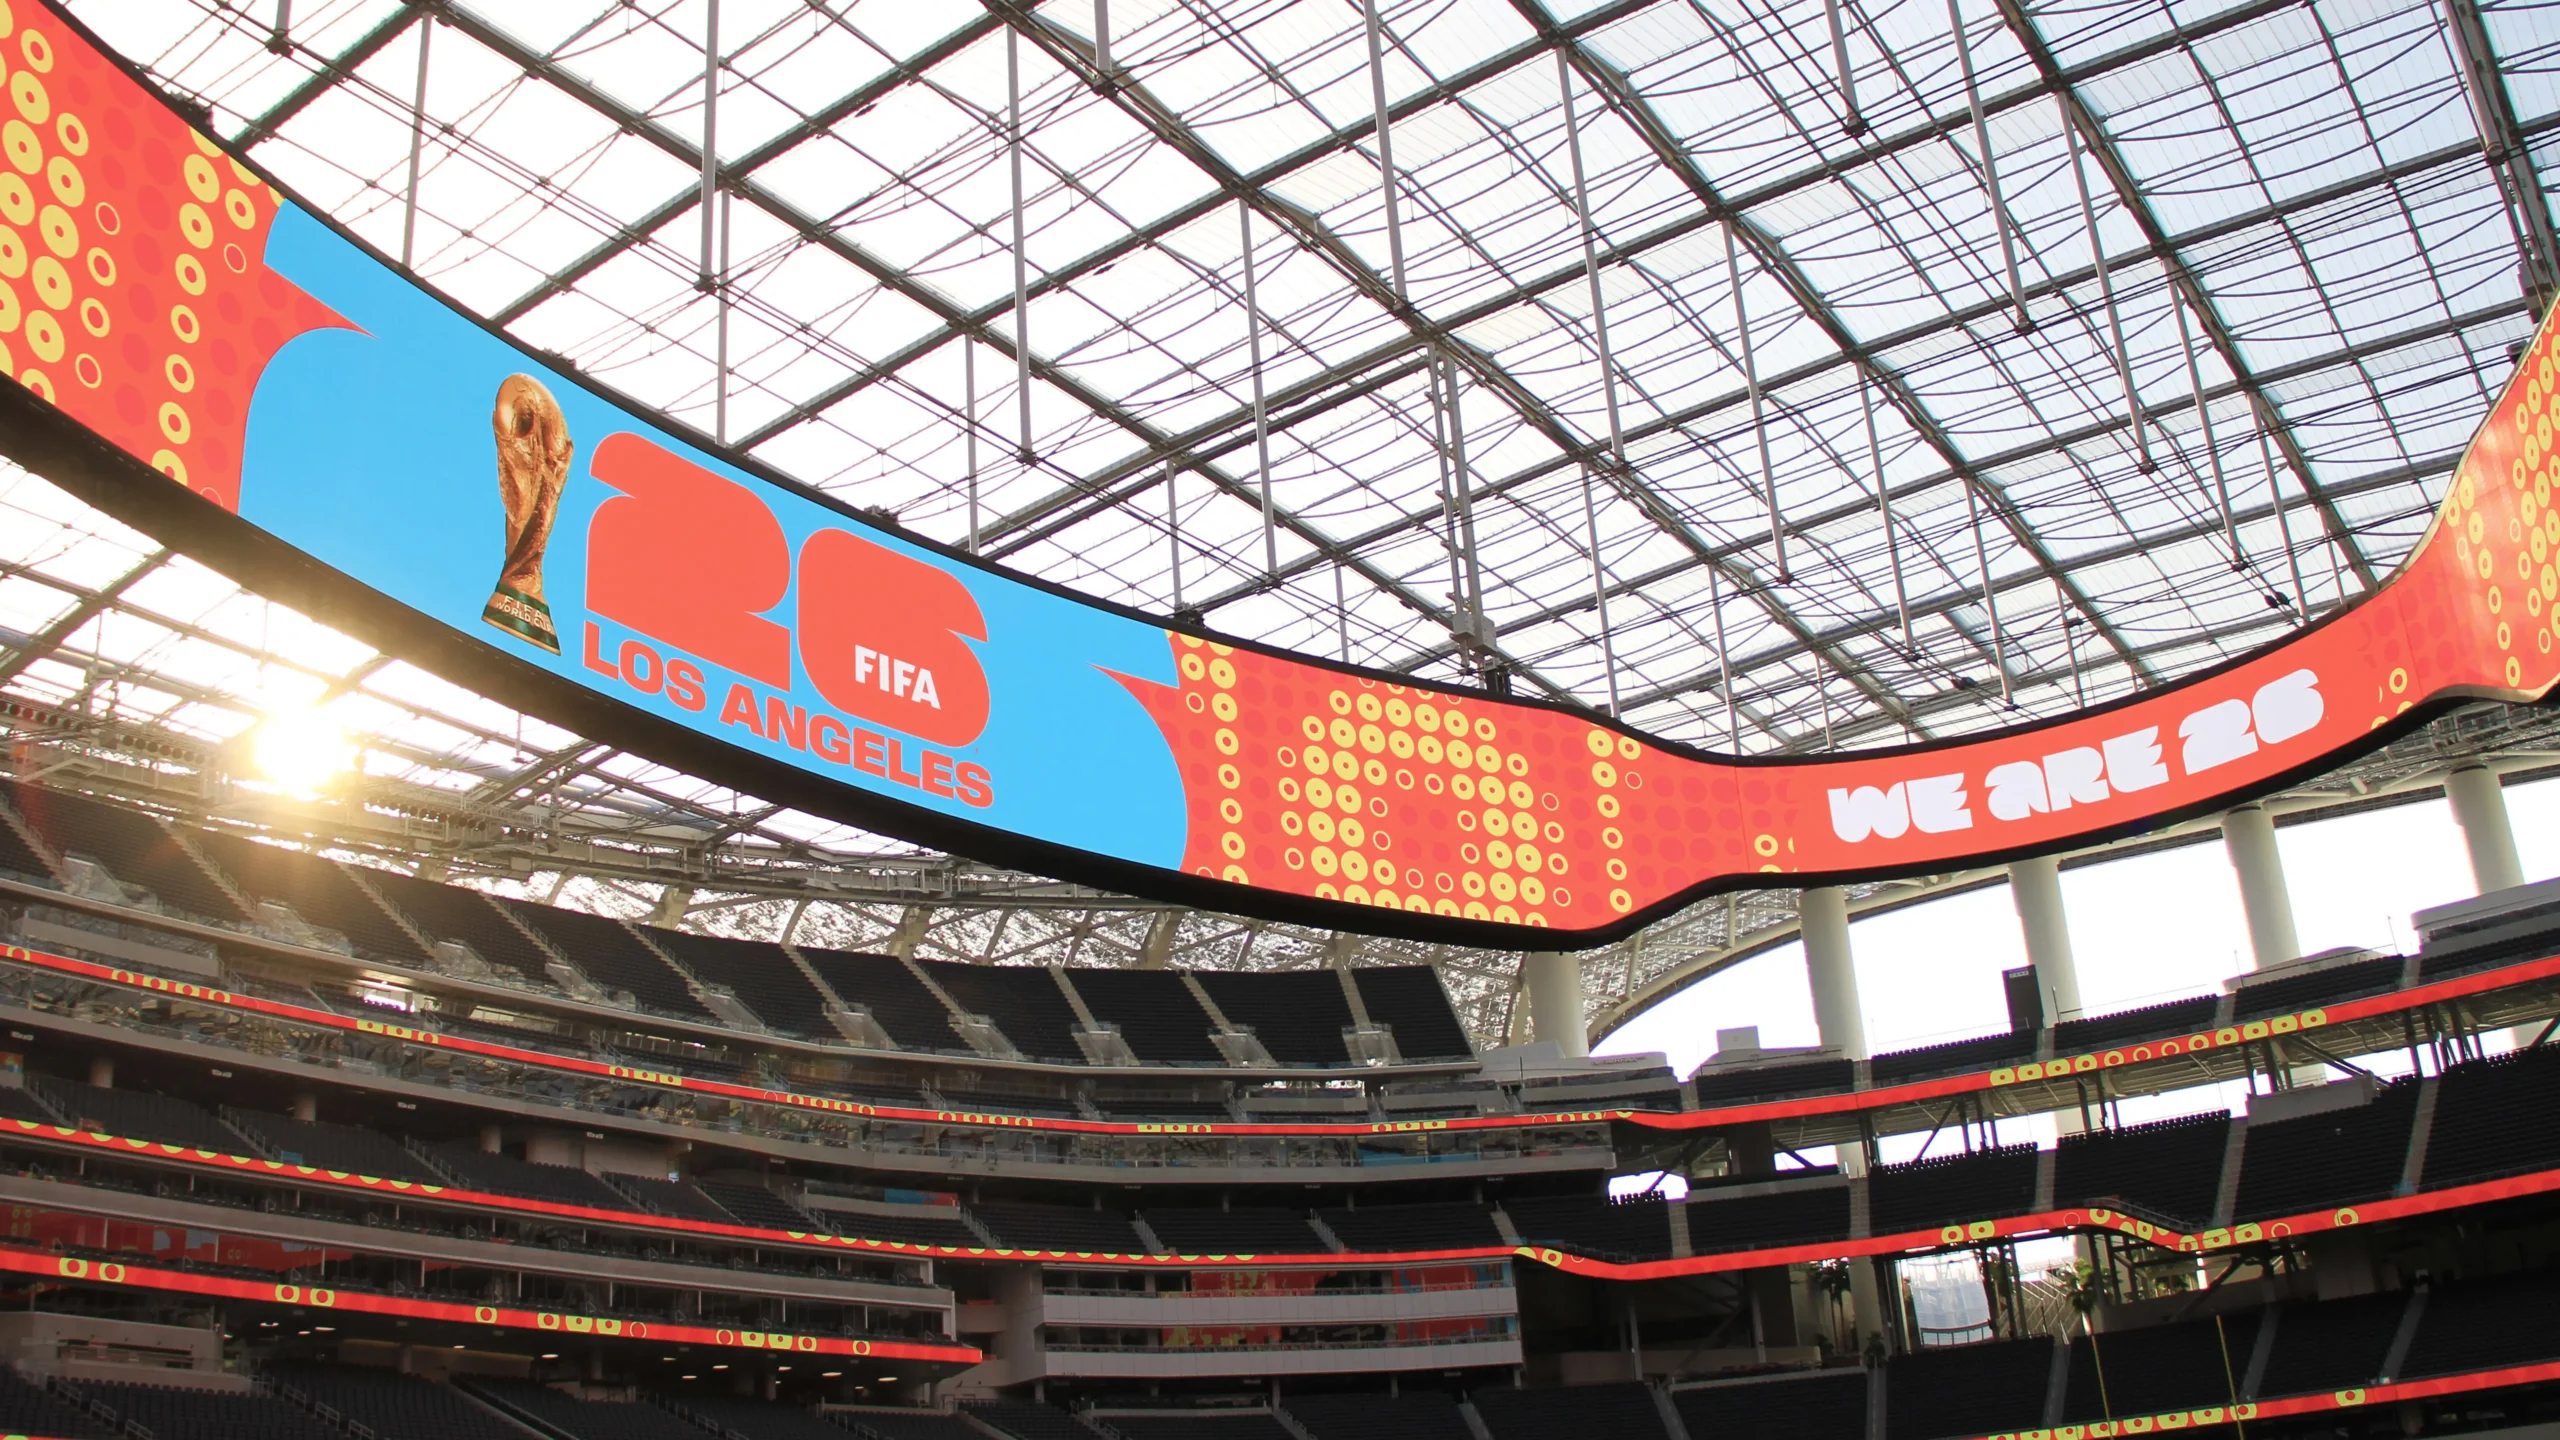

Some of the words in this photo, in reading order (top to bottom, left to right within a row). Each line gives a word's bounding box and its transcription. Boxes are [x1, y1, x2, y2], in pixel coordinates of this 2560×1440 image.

[496, 601, 531, 623] WORLD
[504, 595, 543, 619] FIFA
[585, 431, 990, 748] 26
[583, 620, 706, 712] LOS
[719, 683, 993, 808] ANGELES
[854, 644, 941, 710] FIFA
[1827, 771, 1974, 843] WE
[2178, 667, 2325, 776] 26
